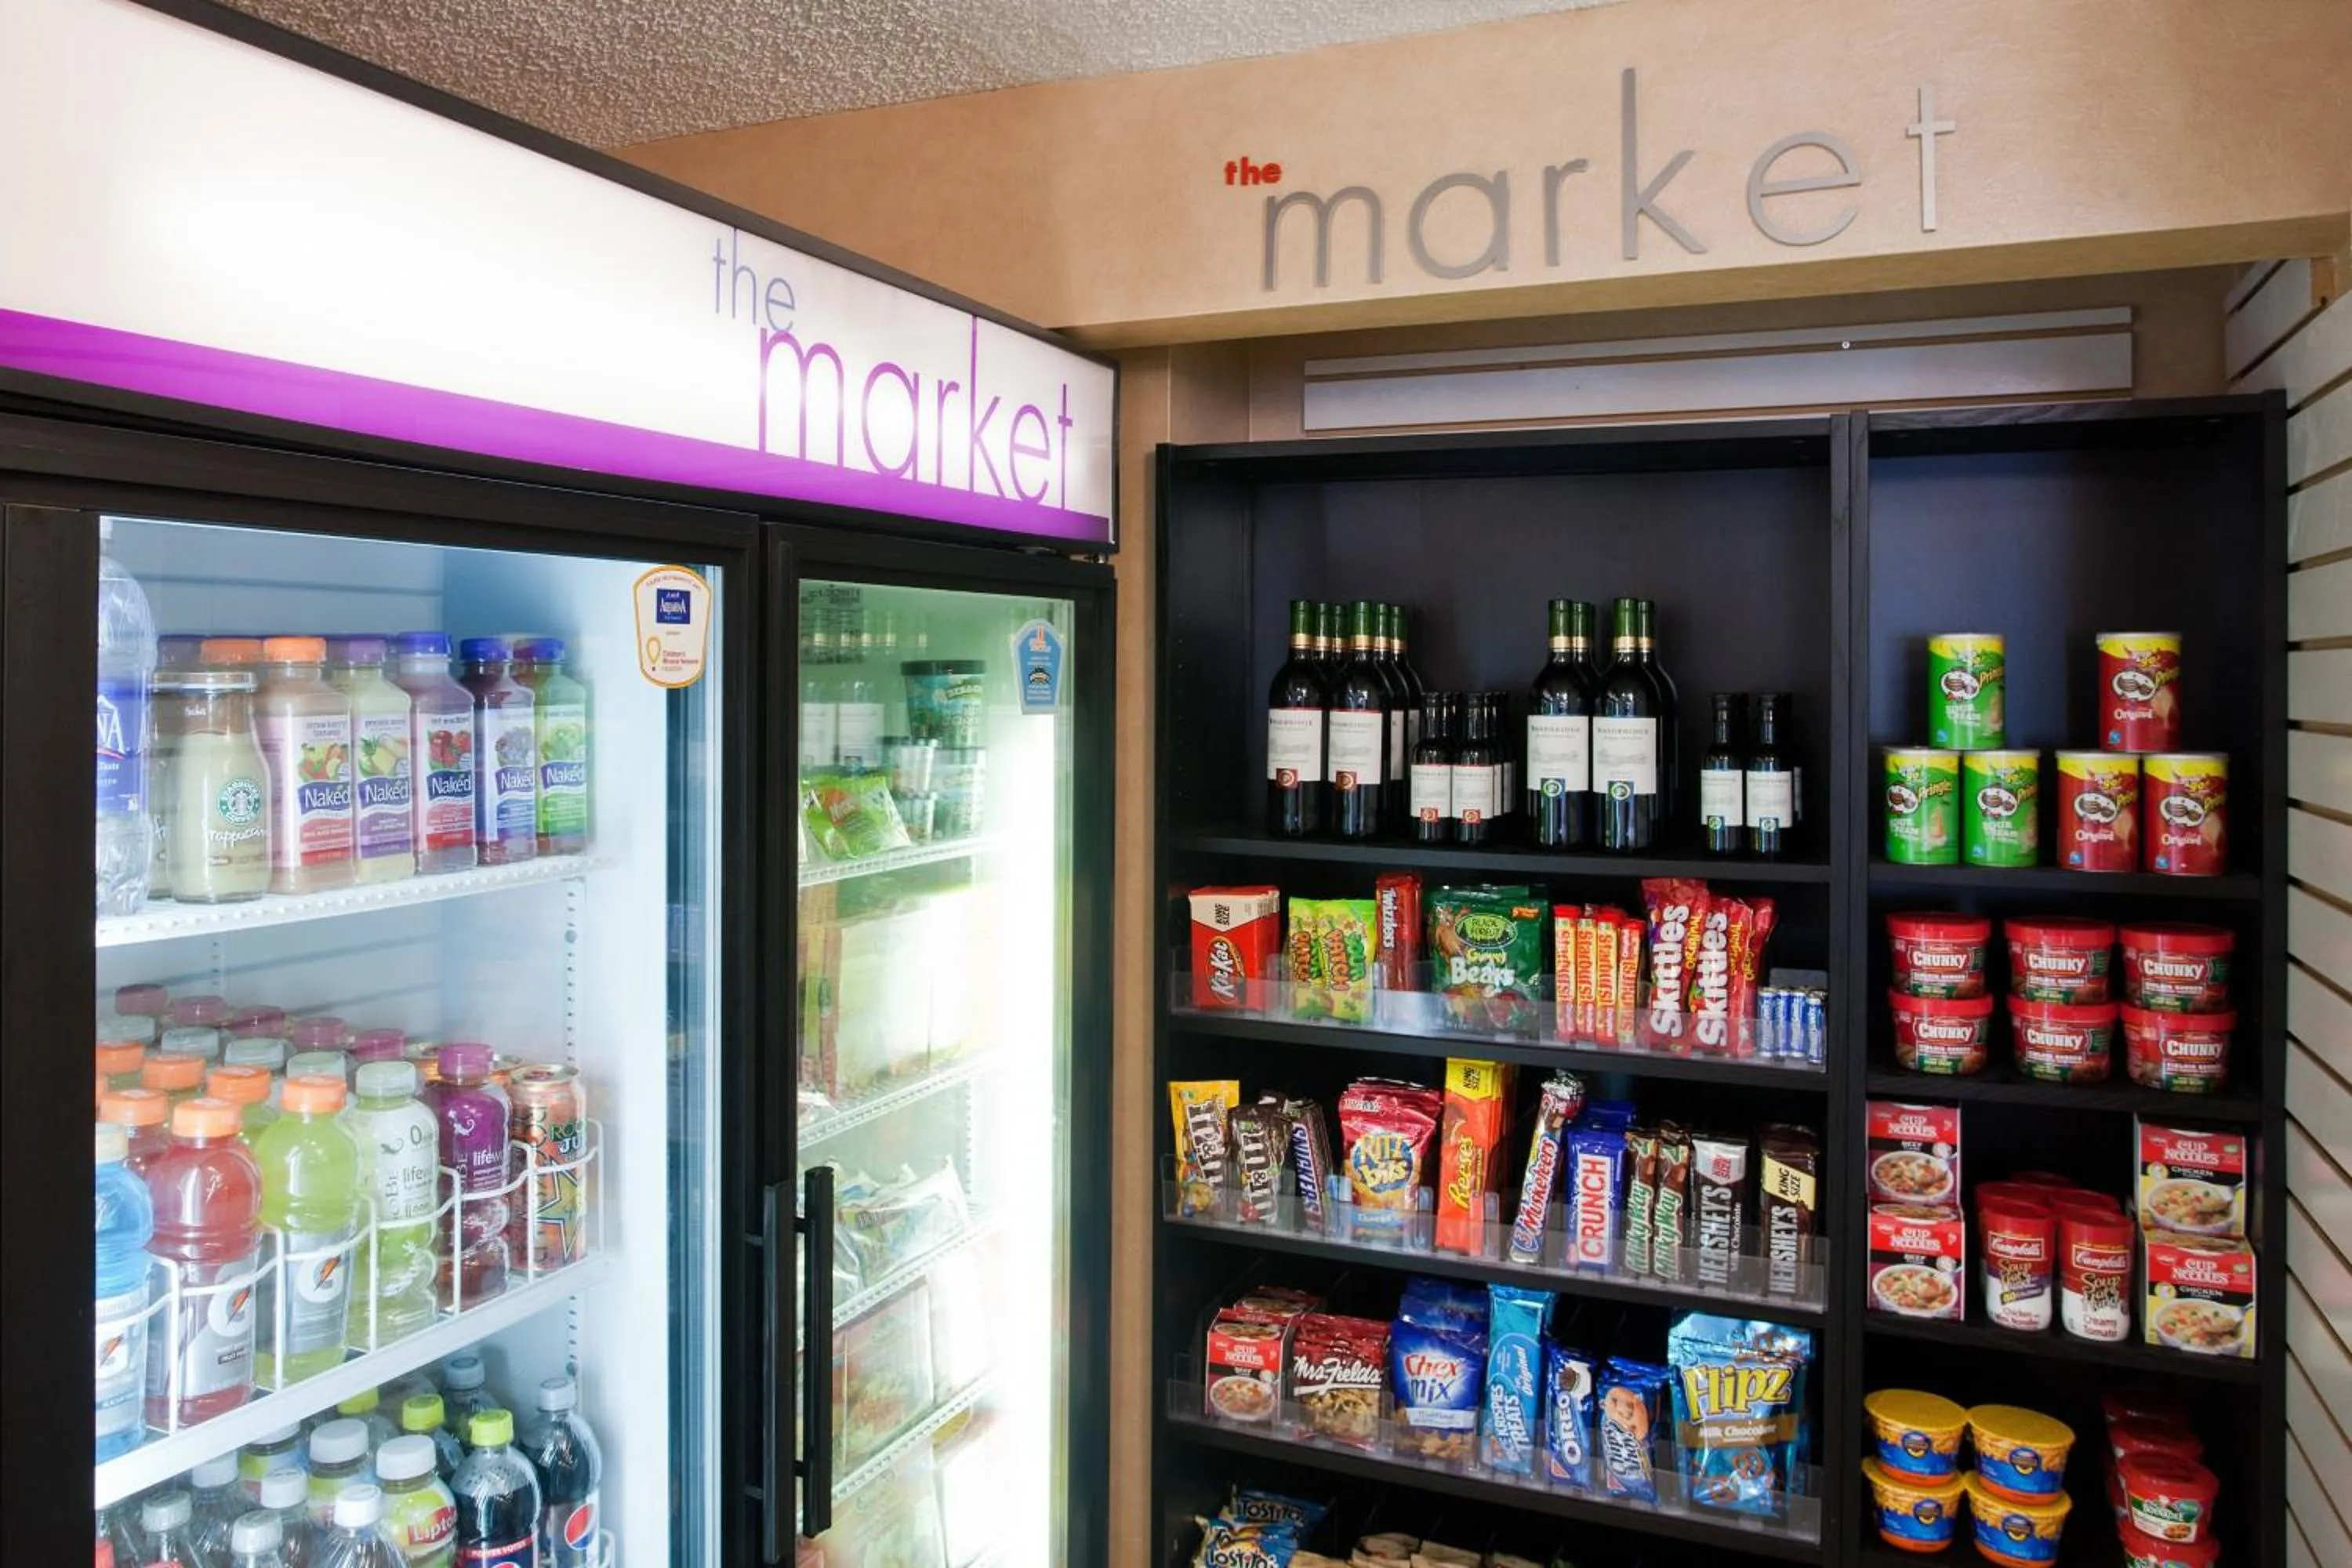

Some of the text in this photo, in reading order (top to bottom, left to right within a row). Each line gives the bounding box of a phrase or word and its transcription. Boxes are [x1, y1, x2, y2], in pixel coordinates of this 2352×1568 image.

[1224, 156, 1283, 186] the
[1263, 67, 1956, 291] market
[712, 227, 796, 332] the
[758, 314, 1073, 511] market
[431, 775, 471, 795] Naked
[546, 764, 585, 783] Naked
[305, 786, 351, 809] Naked
[365, 781, 409, 804] Naked
[1324, 928, 1350, 991] PATCH
[1345, 931, 1367, 982] SOUR
[1450, 956, 1516, 986] Bears
[1579, 930, 1594, 1003] Starburst
[1599, 933, 1613, 1007] Starburst
[1650, 904, 1690, 1037] Skittles
[1697, 912, 1728, 1047] Skittles
[1888, 1123, 1937, 1137] NOODLES
[1900, 1113, 1927, 1126] CUP
[2163, 1148, 2220, 1165] NOODLES
[2176, 1139, 2208, 1152] CUP
[1292, 1122, 1322, 1216] SNICKERS
[1777, 1167, 1790, 1196] KING
[2171, 1165, 2214, 1177] CHICKEN
[1791, 1174, 1801, 1199] SIZE
[1581, 1159, 1606, 1258] CRUNCH
[1890, 1236, 1941, 1251] NOODLES
[1902, 1226, 1932, 1239] CUP
[2172, 1266, 2229, 1284] NOODLES
[2185, 1258, 2218, 1271] CUP
[2179, 1285, 2223, 1298] CHICKEN
[1321, 1356, 1382, 1394] Fields
[1682, 1364, 1795, 1425] Flipz
[1504, 1394, 1534, 1451] TREATS
[1557, 1391, 1582, 1466] OREO
